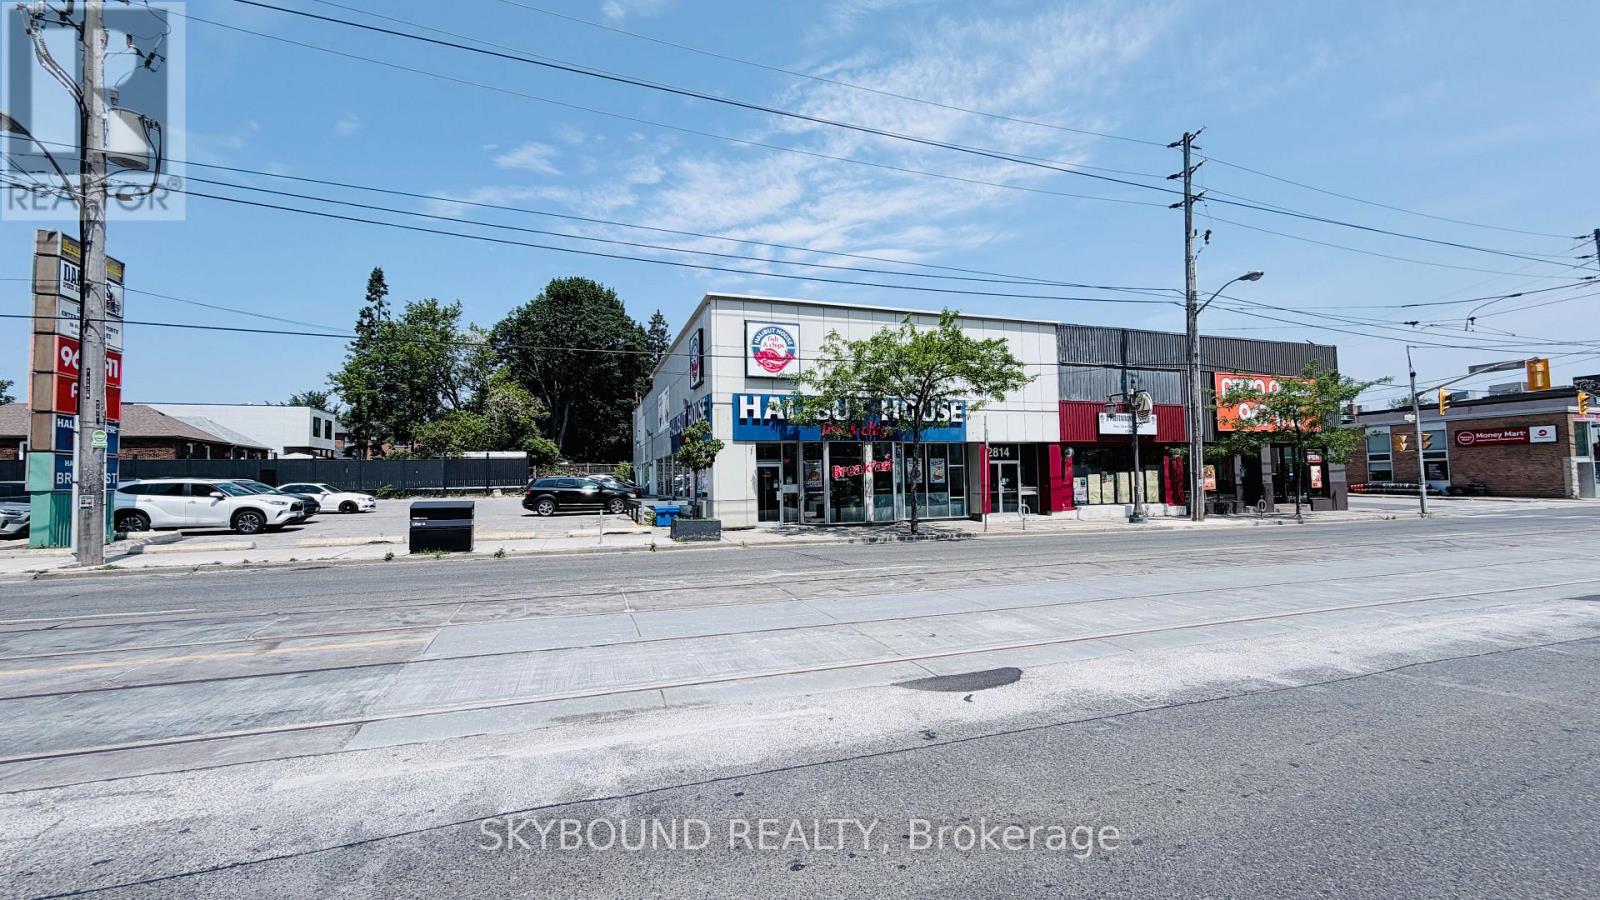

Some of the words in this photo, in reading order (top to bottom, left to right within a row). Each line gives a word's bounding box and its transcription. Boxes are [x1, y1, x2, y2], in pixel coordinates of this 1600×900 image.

[881, 399, 963, 422] HOUSE
[987, 447, 1010, 457] 2814
[832, 459, 895, 480] Breakfast
